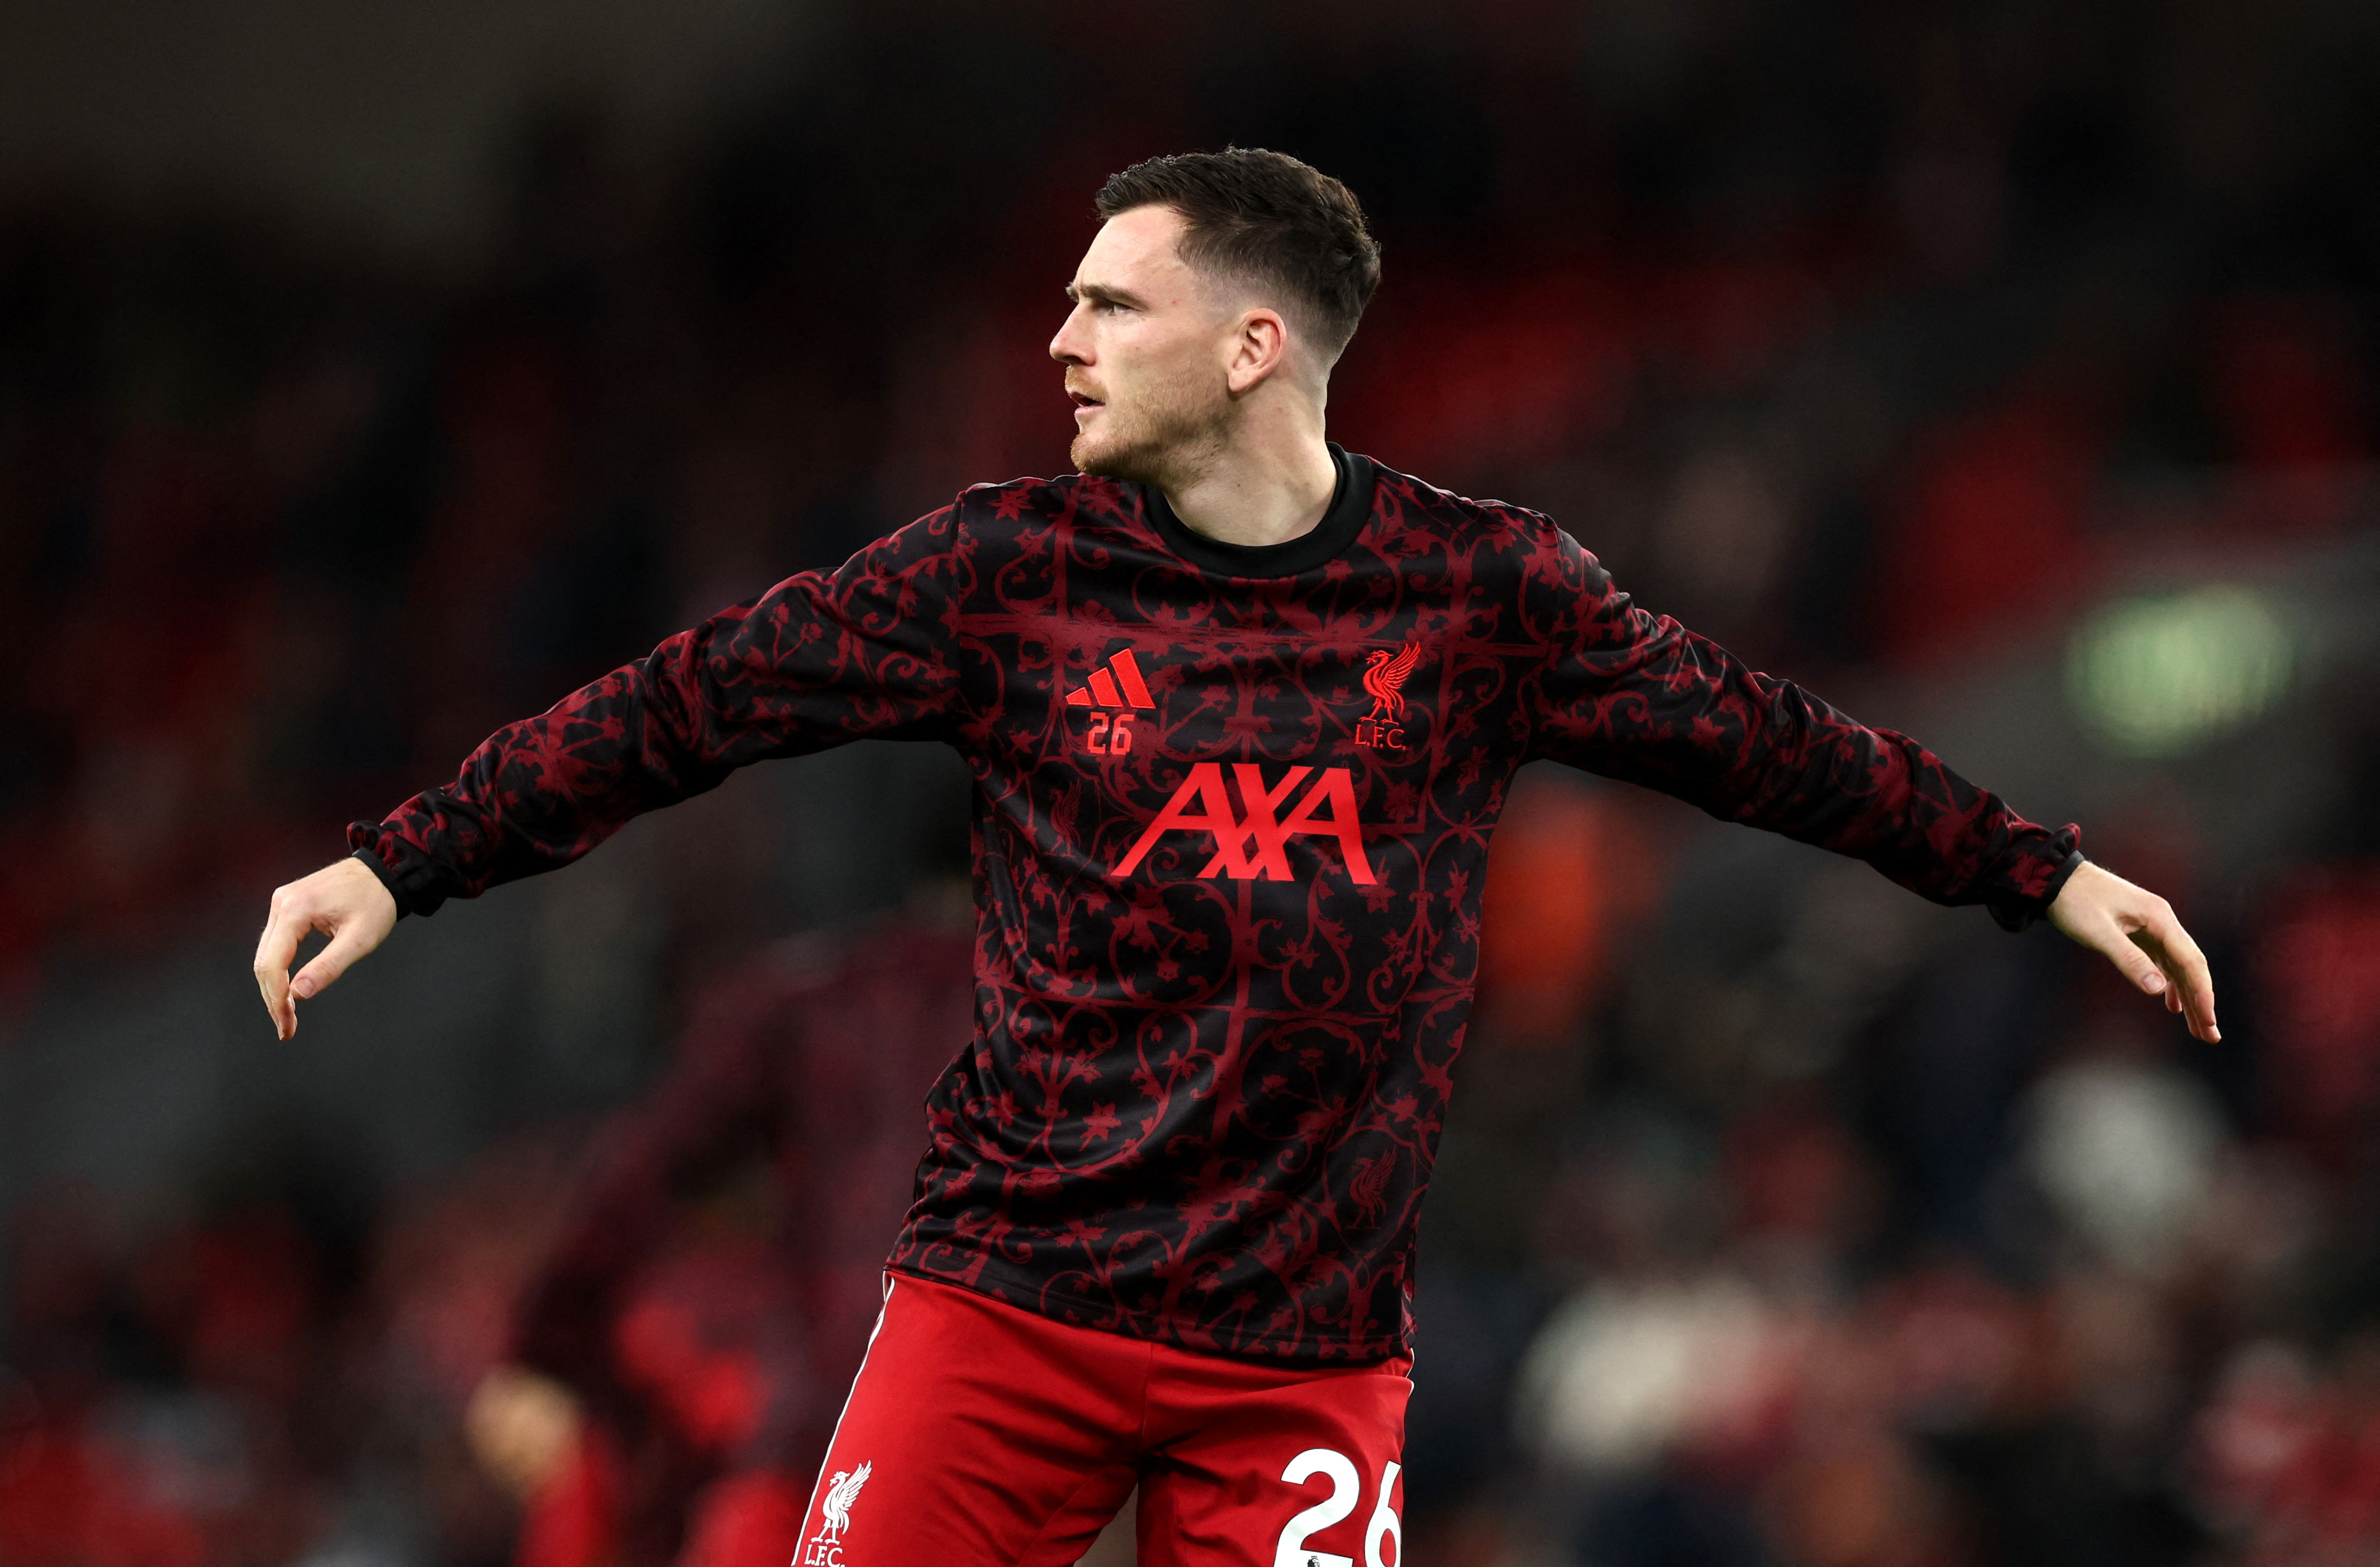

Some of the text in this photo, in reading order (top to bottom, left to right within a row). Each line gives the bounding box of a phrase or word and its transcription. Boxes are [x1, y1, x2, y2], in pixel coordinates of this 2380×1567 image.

[1087, 712, 1134, 755] 26
[1354, 724, 1406, 751] L.F.C.
[1111, 762, 1378, 885] AXA
[1273, 1448, 1402, 1567] 26
[804, 1544, 845, 1567] L.F.C.
